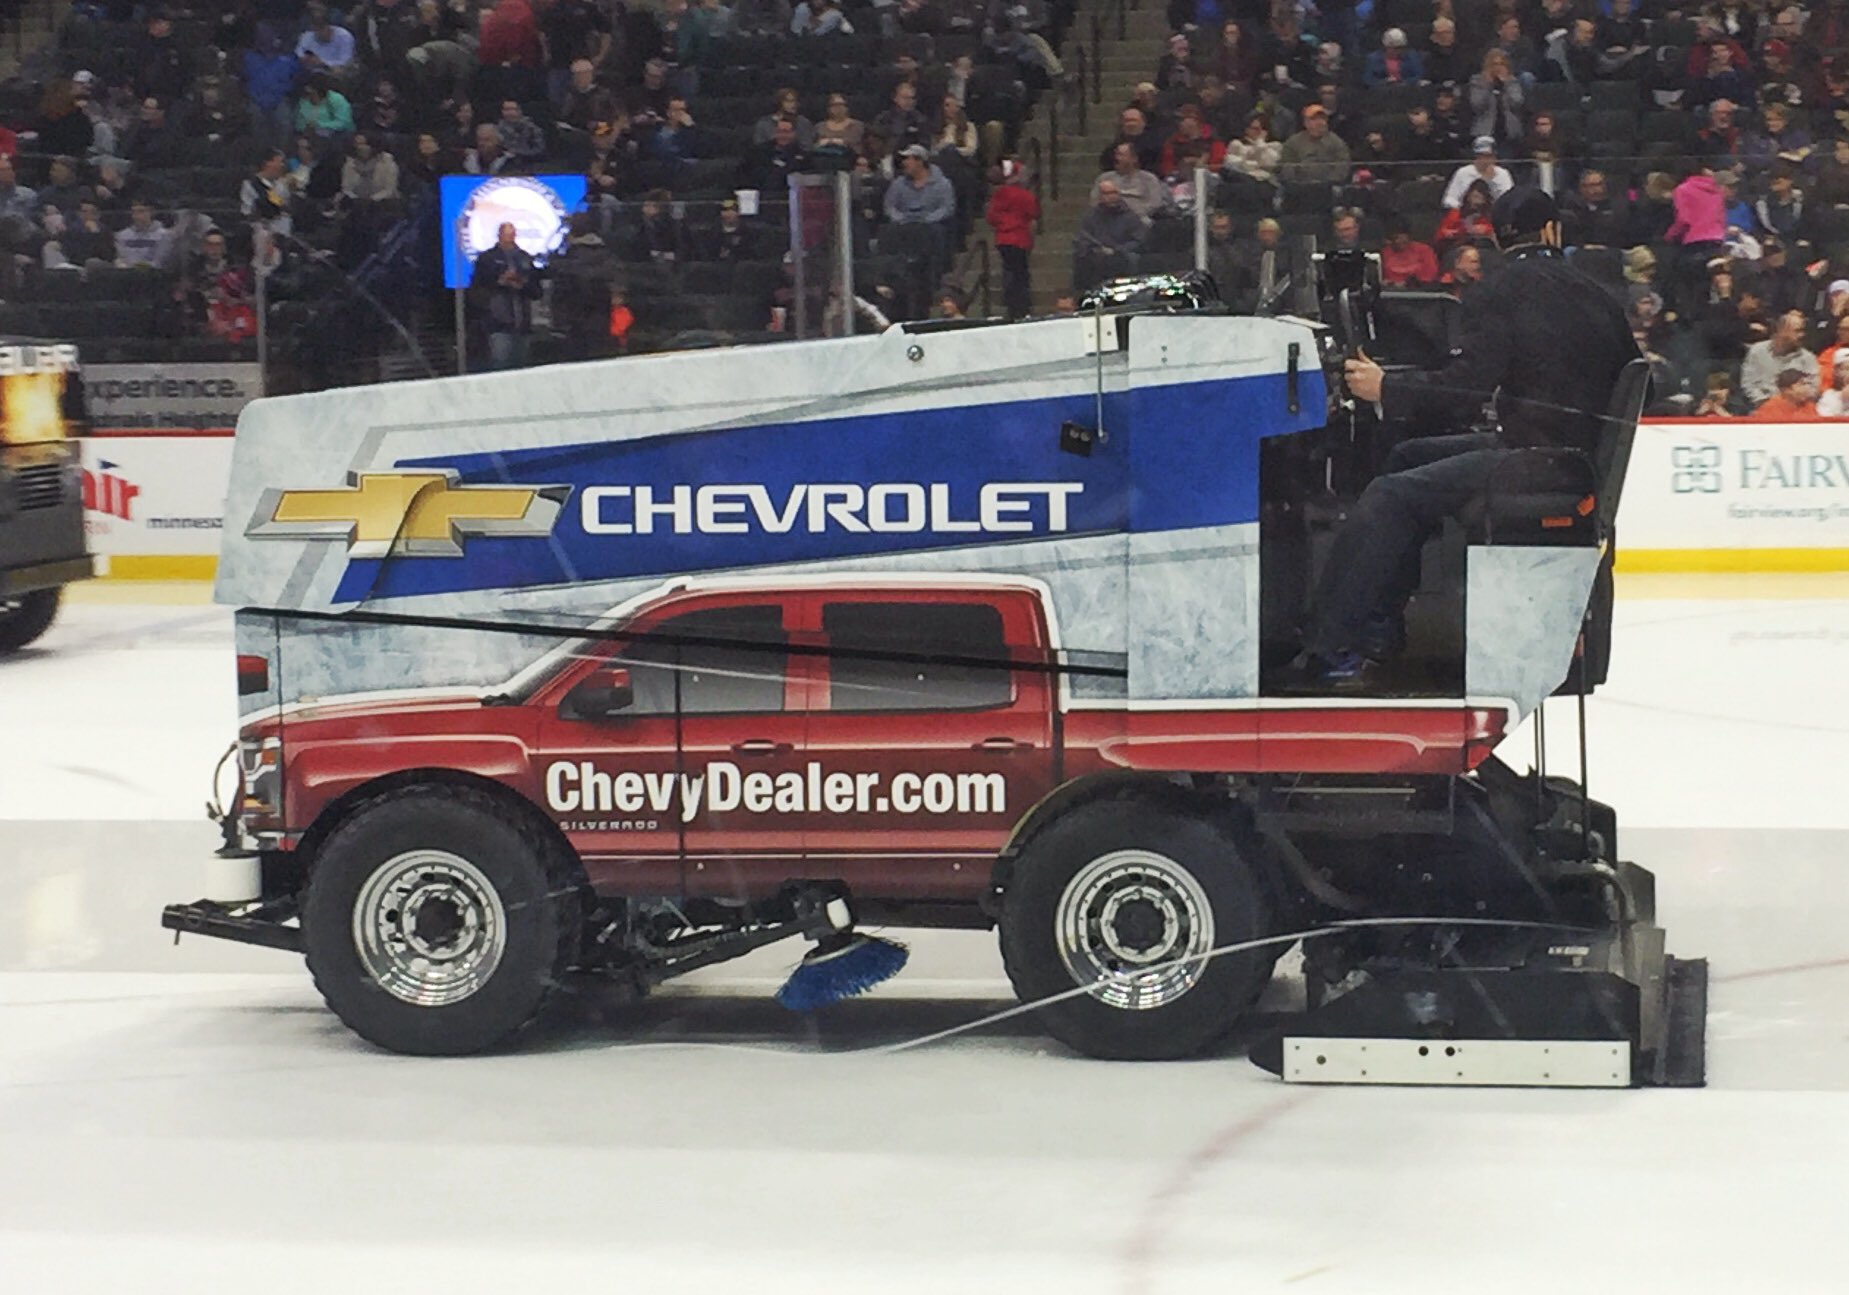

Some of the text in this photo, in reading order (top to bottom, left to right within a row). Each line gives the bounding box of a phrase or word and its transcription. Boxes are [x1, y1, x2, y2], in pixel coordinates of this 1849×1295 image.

[581, 482, 1084, 534] CHEVROLET
[546, 761, 1006, 823] ChevyDealer.com
[559, 820, 659, 831] SILVERADO
